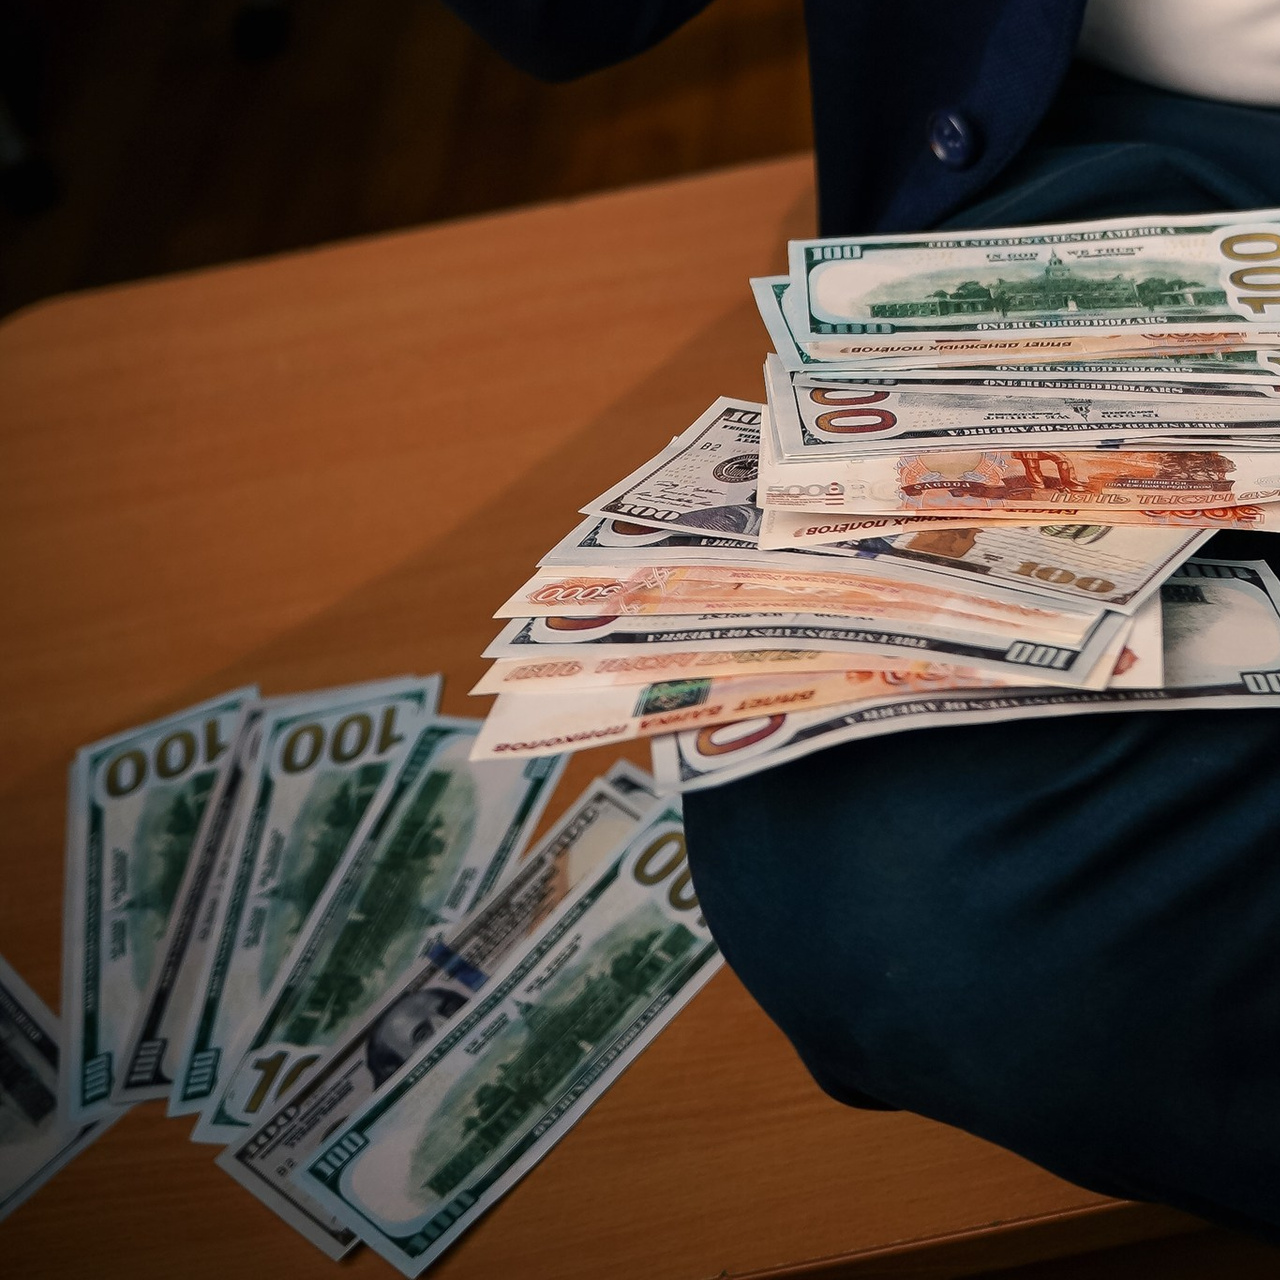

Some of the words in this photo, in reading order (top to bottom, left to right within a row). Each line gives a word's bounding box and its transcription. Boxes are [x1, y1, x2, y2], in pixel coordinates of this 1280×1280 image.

[811, 245, 862, 260] 100
[722, 411, 761, 425] 10
[616, 503, 682, 521] 100
[1011, 561, 1116, 593] 100
[1006, 642, 1071, 669] 100
[282, 707, 404, 774] 100
[106, 720, 225, 797] 100
[316, 1130, 369, 1176] 100
